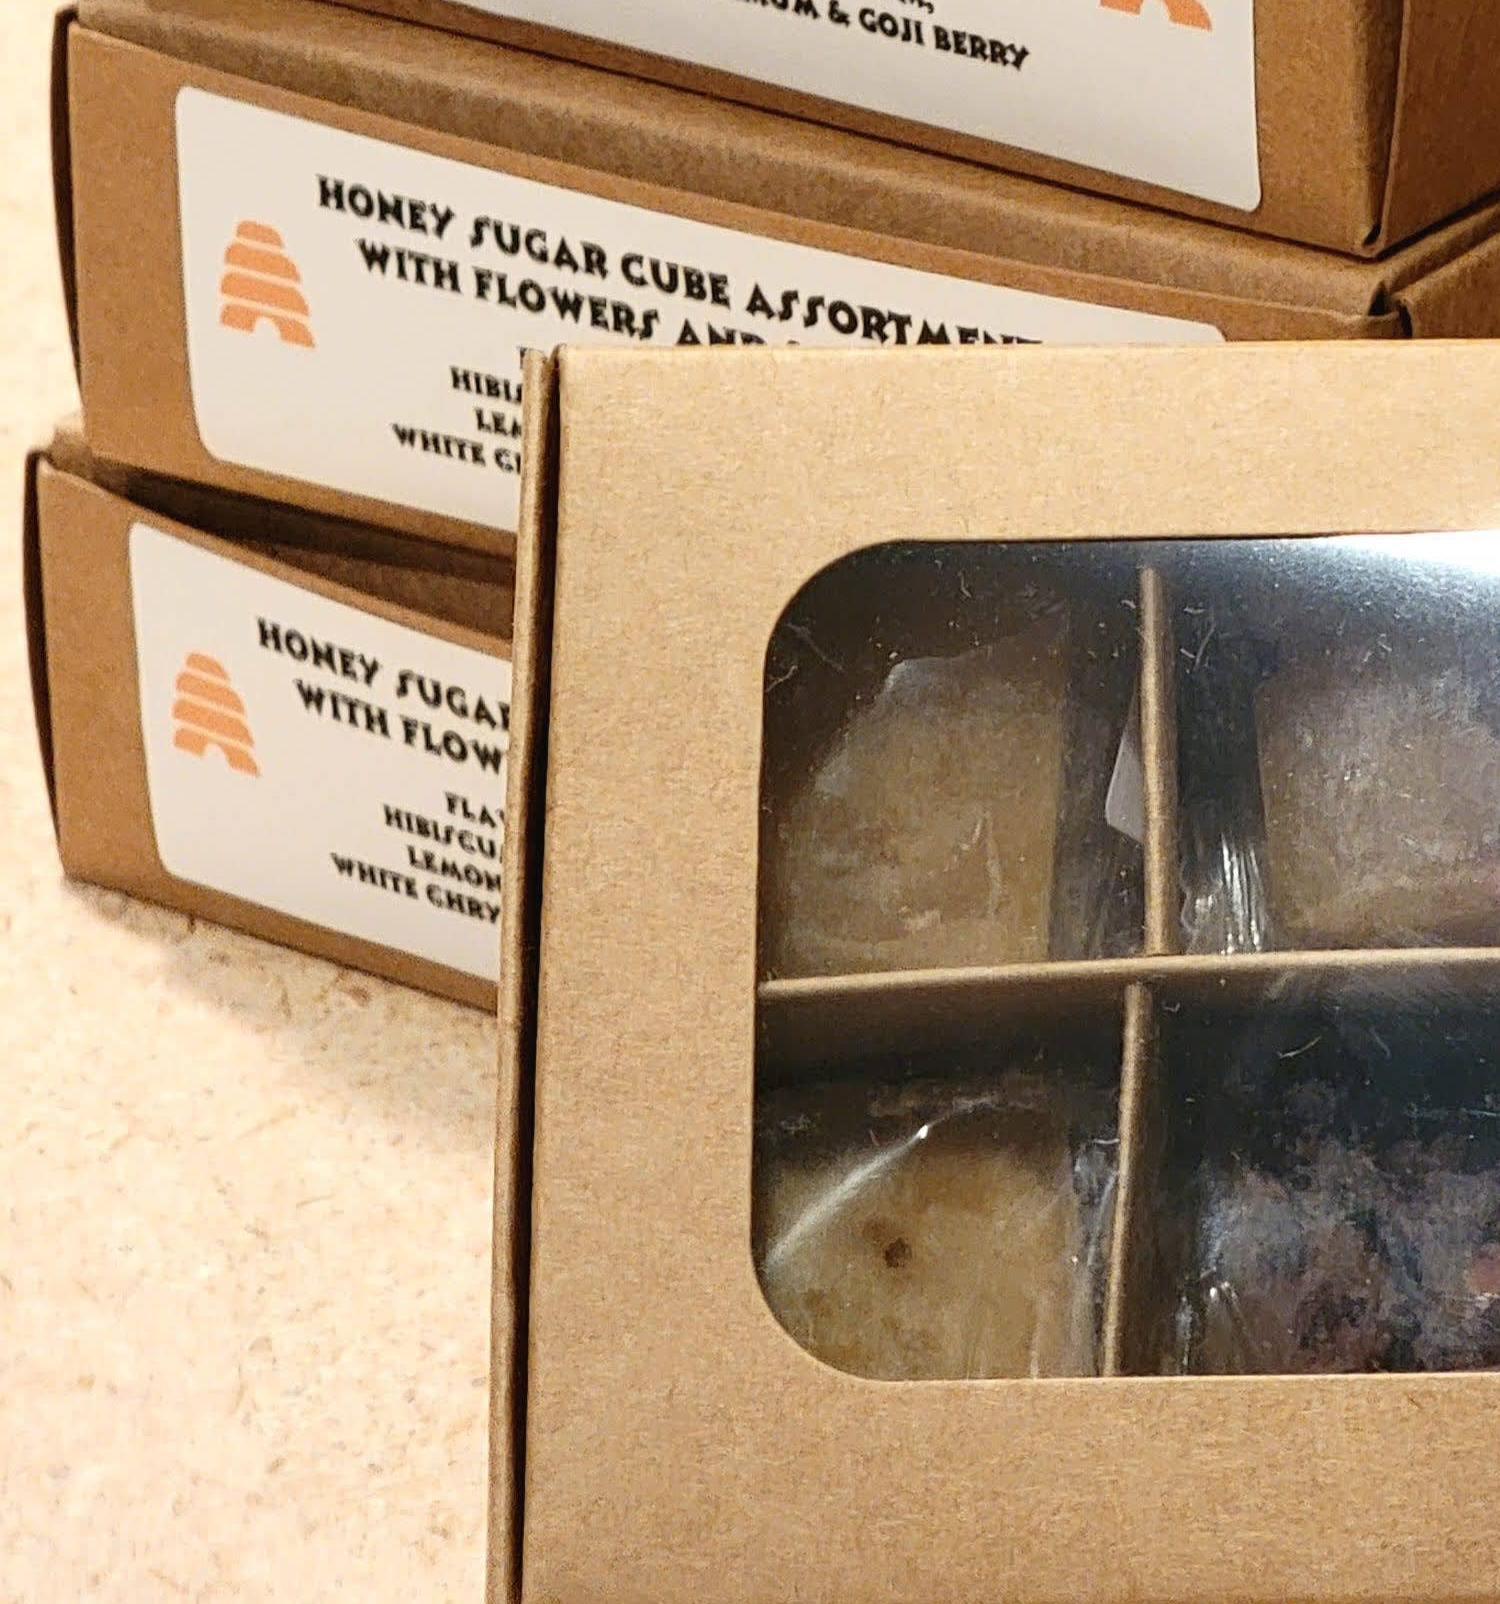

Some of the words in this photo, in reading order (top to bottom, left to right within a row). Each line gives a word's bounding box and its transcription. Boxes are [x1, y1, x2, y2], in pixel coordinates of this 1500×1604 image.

[827, 0, 851, 27] &
[858, 7, 925, 46] GOJI
[933, 25, 1030, 71] BERRY
[319, 177, 455, 239] HONEY
[470, 217, 609, 280] SUGAR
[620, 253, 731, 309] CUBE
[359, 239, 461, 293] WITH
[474, 269, 660, 341] FLOWERS
[391, 422, 486, 467] WHITE
[258, 619, 379, 686] HONEY
[296, 679, 389, 737] WITH
[383, 803, 502, 864] HIBISCU
[330, 853, 418, 900] WHITE
